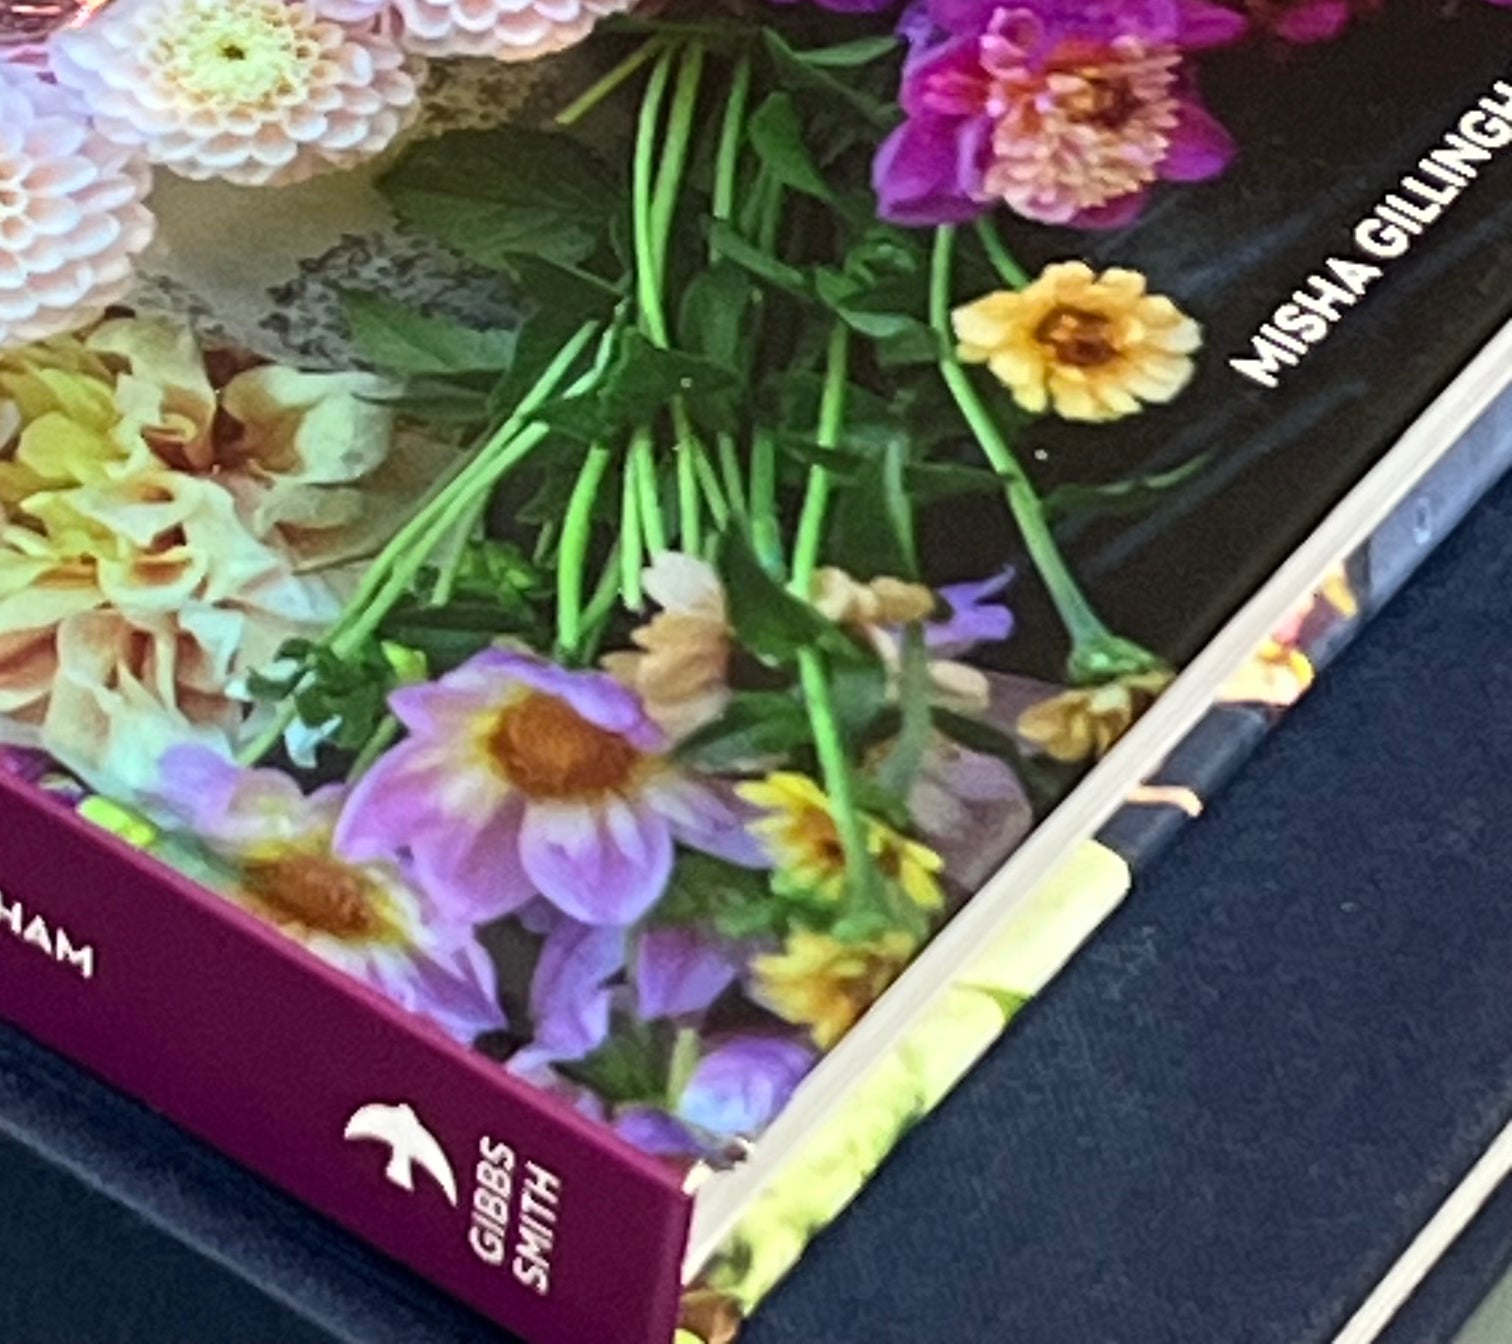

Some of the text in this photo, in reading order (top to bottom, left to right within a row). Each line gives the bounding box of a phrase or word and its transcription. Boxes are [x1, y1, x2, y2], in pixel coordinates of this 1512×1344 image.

[1229, 257, 1383, 388] MISHA
[468, 1135, 515, 1266] GIBBS
[512, 1160, 561, 1295] SMITH
